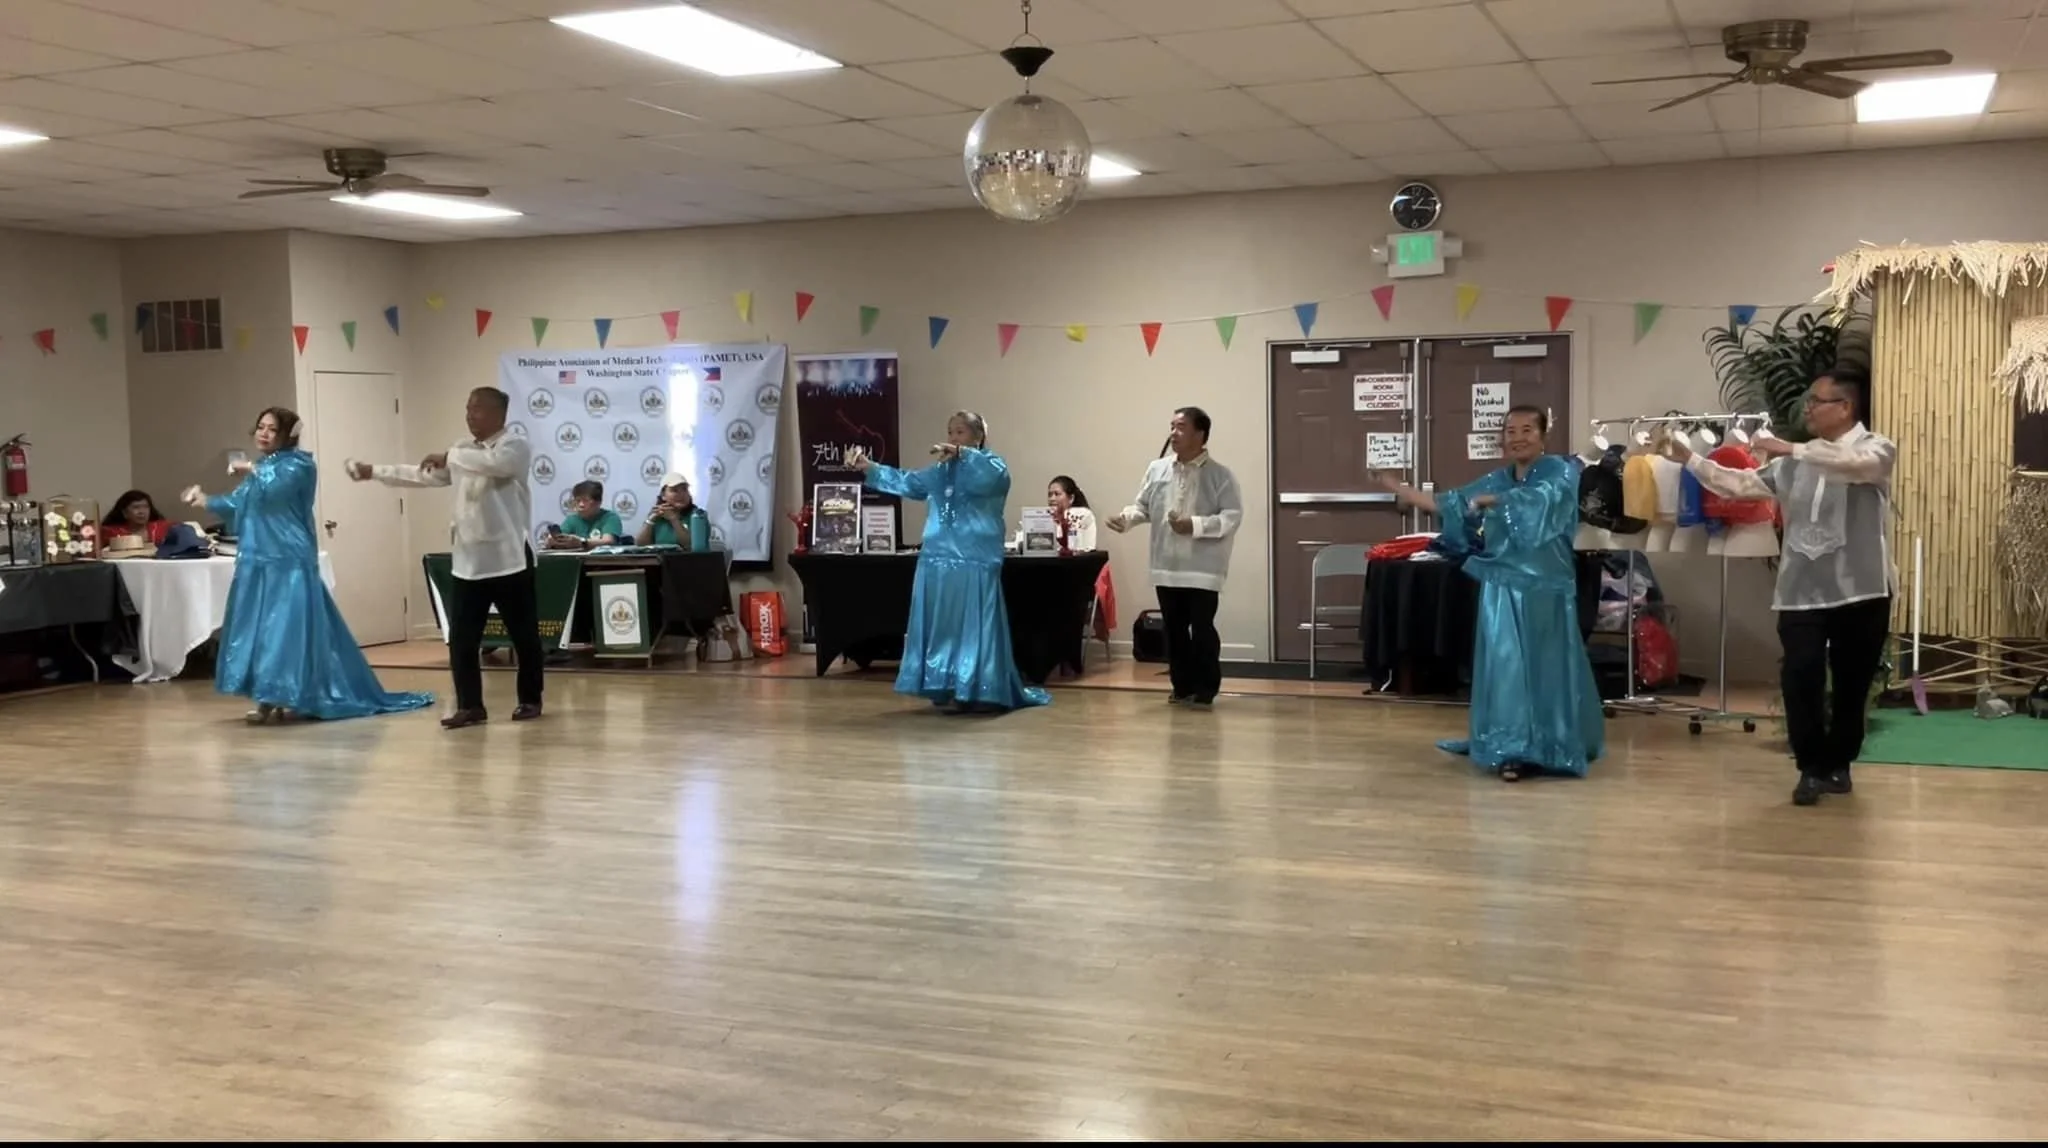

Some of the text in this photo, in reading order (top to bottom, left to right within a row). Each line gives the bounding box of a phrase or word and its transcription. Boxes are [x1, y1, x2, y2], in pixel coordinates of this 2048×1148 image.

[518, 358, 557, 368] Philippine
[559, 358, 600, 366] Association
[602, 357, 610, 365] of
[612, 356, 643, 365] Medical
[745, 352, 764, 361] USA
[586, 369, 633, 378] Washington
[634, 368, 654, 377] State
[812, 441, 839, 466] 7th
